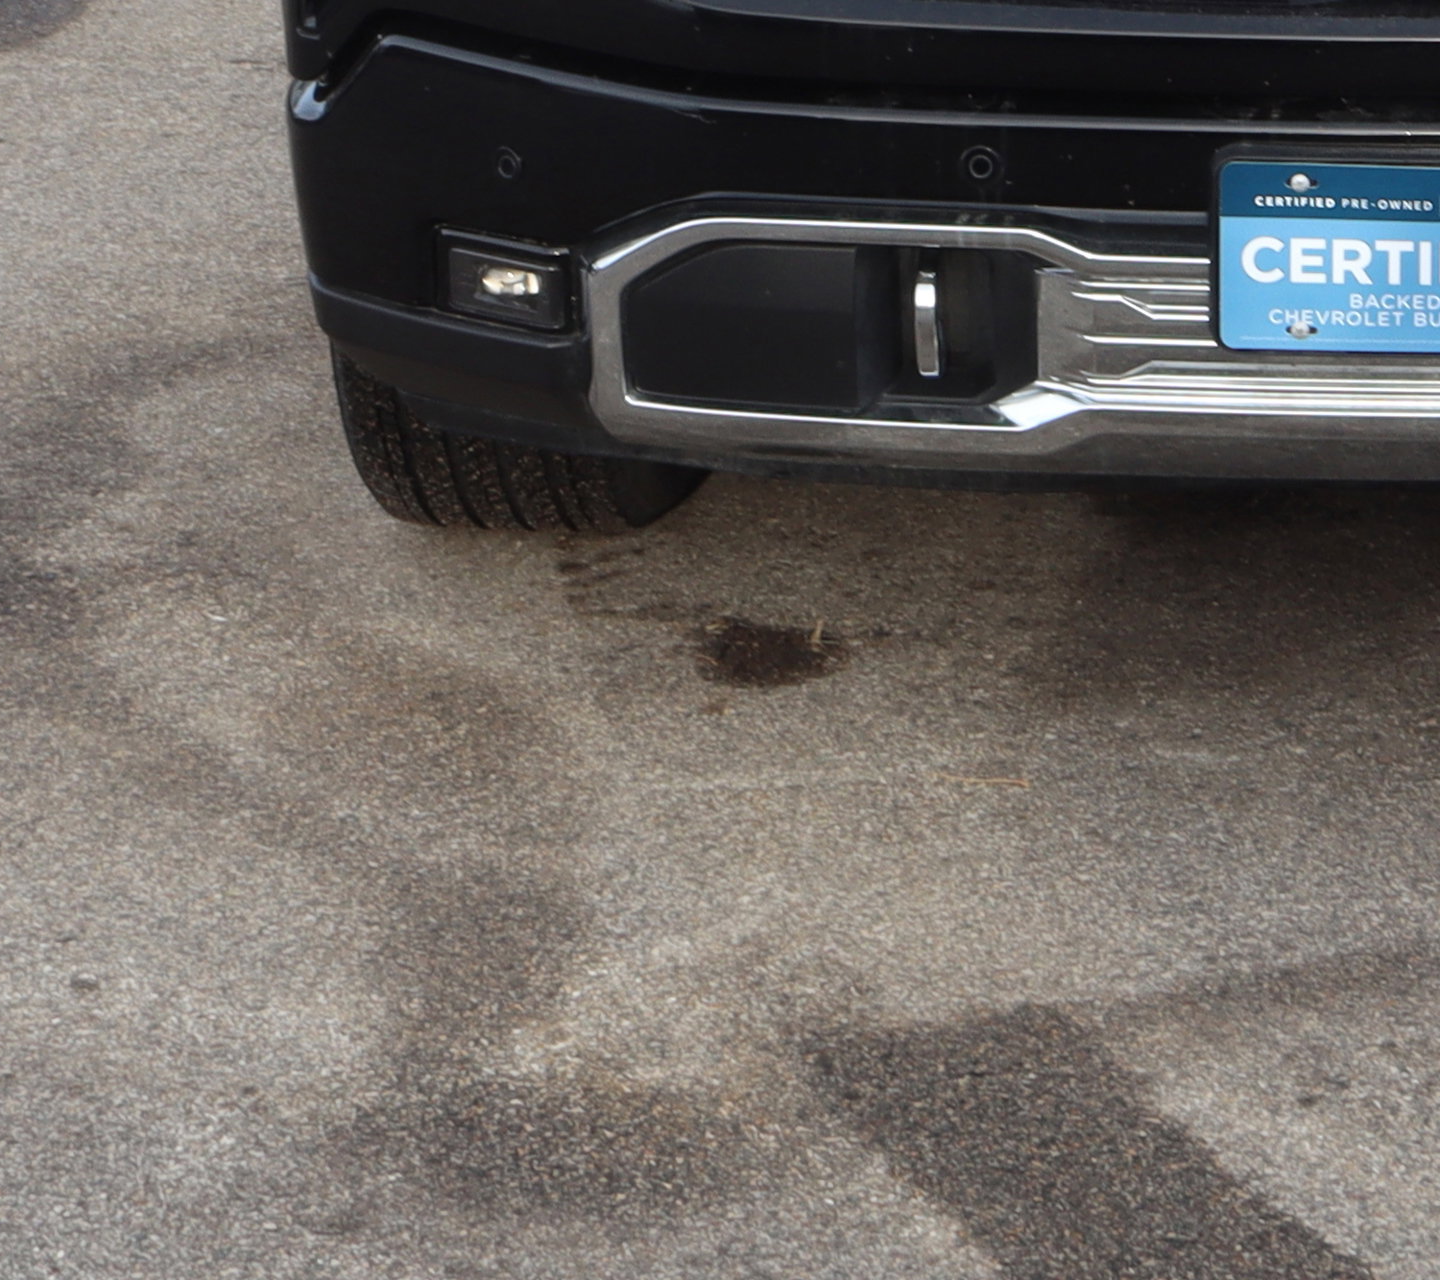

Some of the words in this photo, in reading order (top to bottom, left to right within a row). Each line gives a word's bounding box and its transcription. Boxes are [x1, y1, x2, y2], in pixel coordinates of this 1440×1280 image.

[1253, 194, 1336, 208] CERTIFIED
[1340, 197, 1434, 212] PRE-OWNED
[1268, 308, 1404, 328] CHEVROLET
